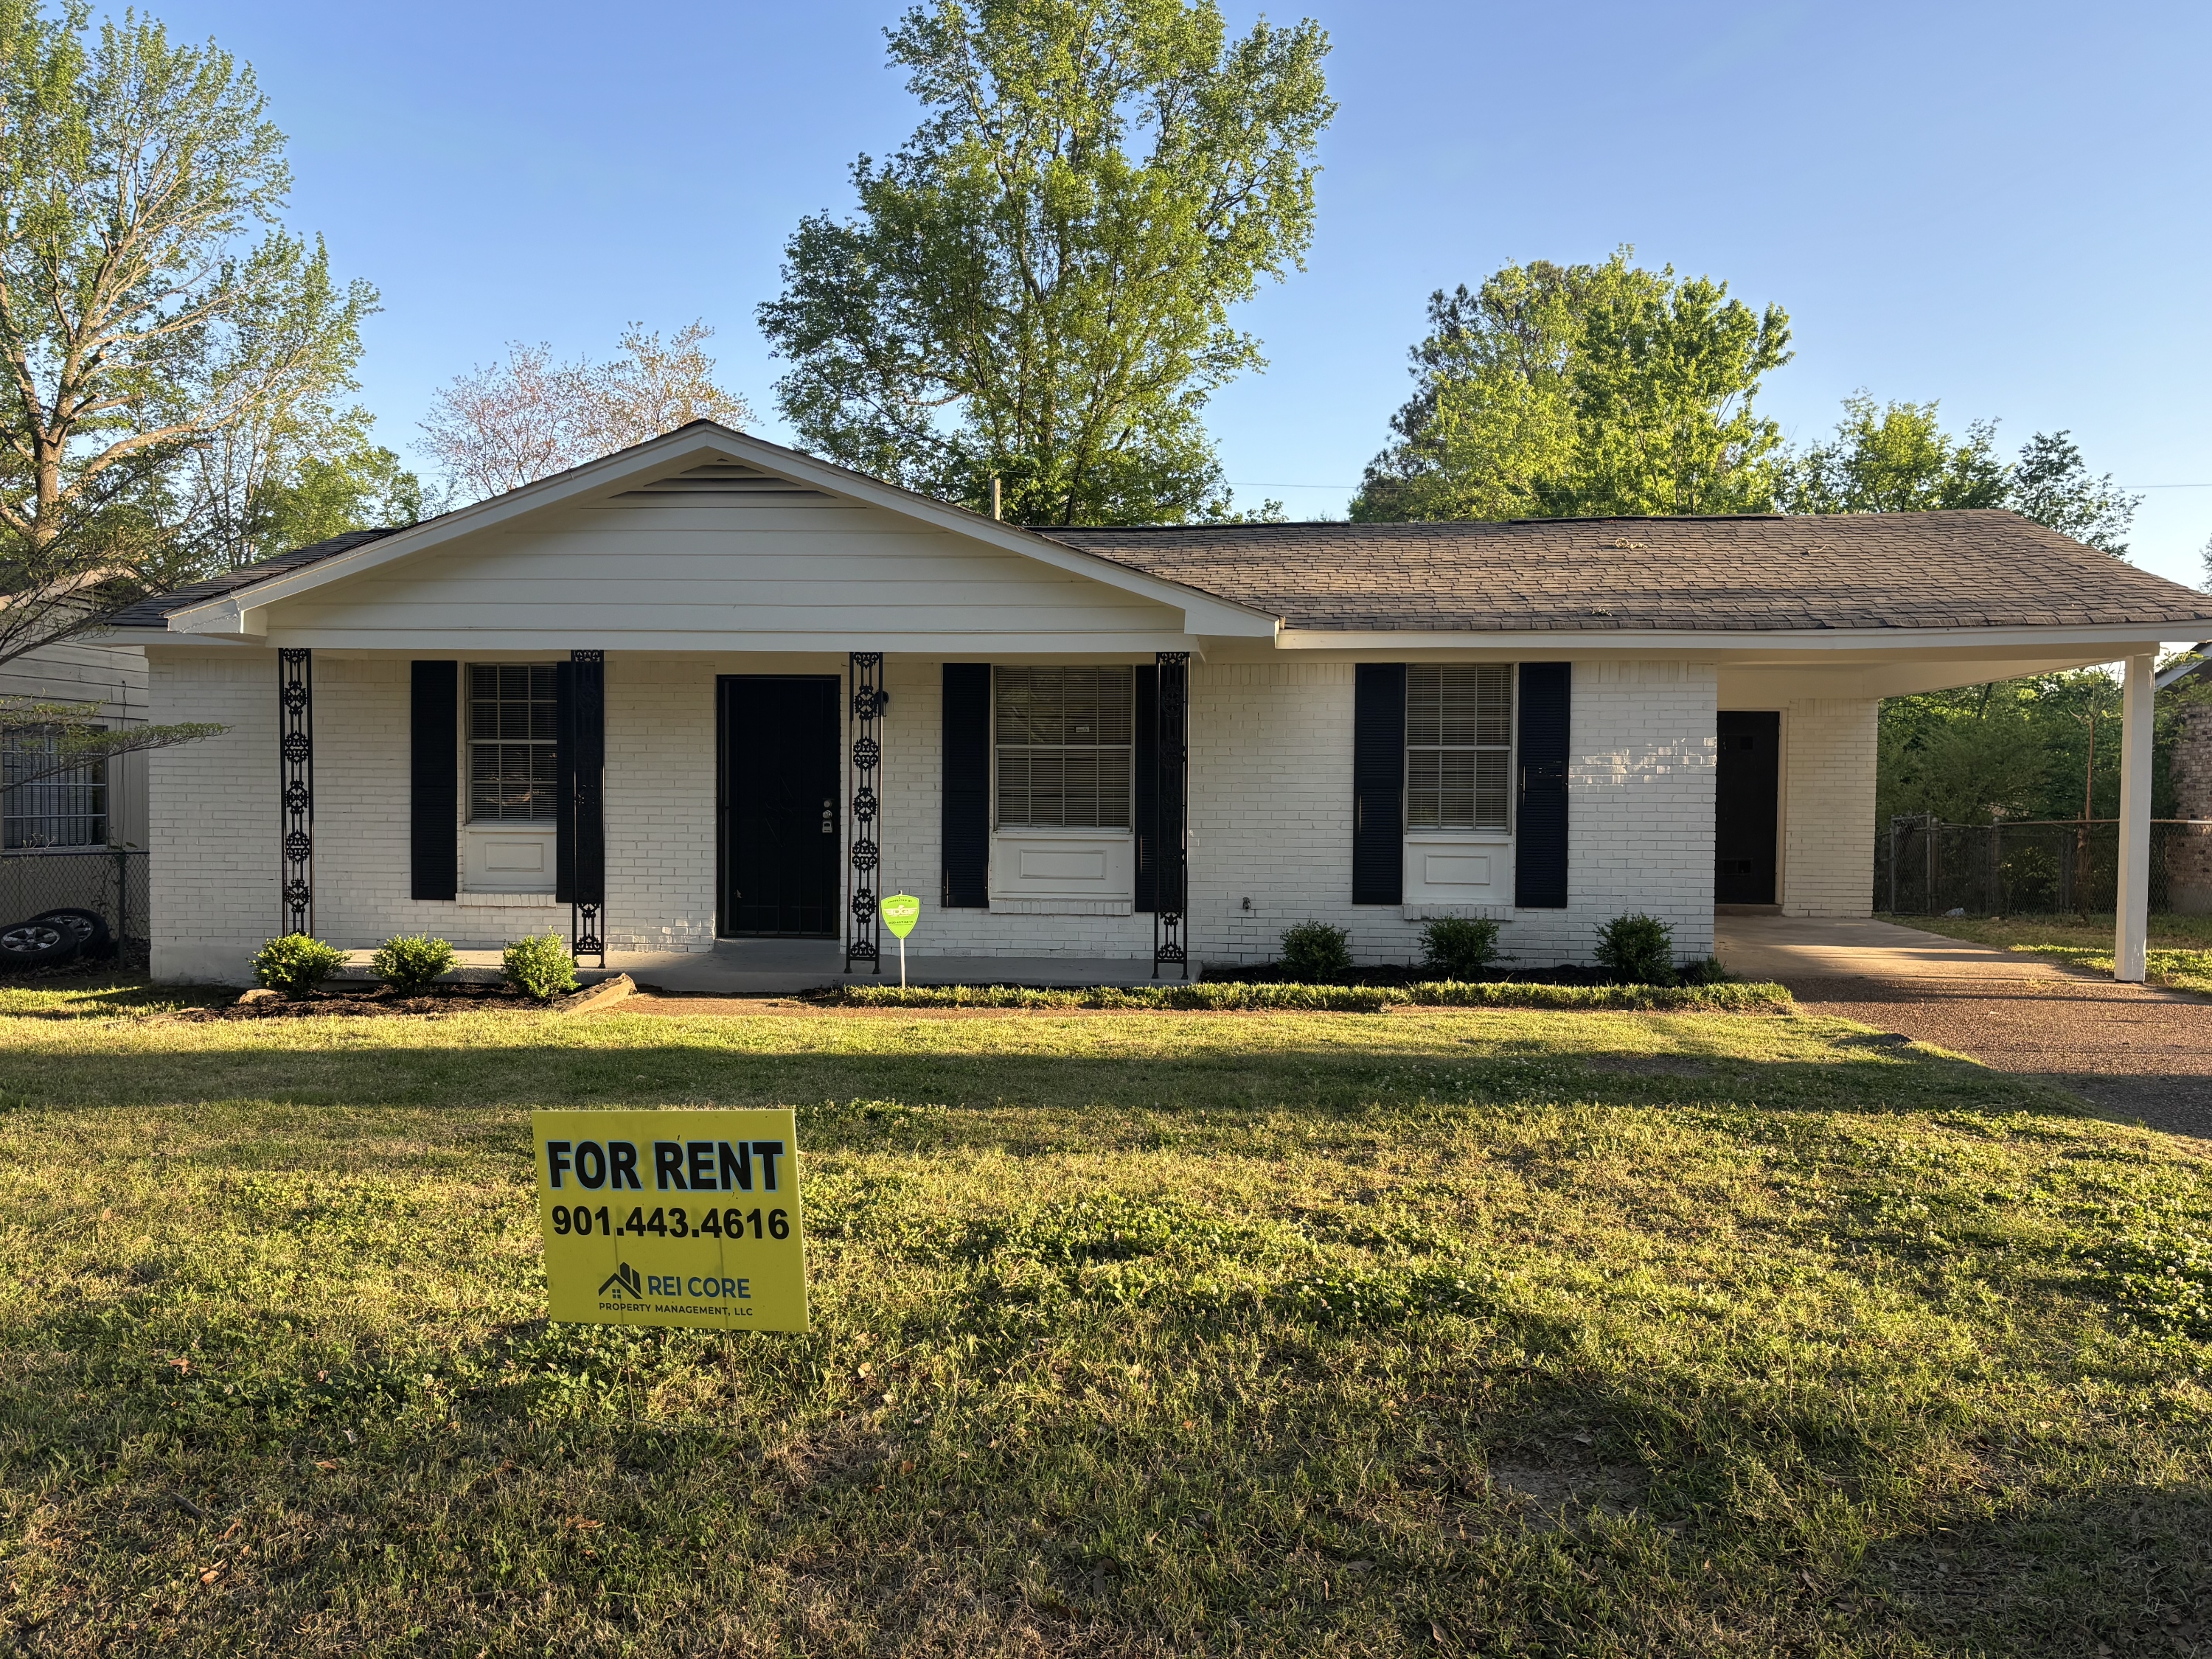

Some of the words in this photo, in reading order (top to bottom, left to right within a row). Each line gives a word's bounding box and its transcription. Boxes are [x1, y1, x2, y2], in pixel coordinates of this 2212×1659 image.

[546, 1140, 644, 1191] FOR
[653, 1140, 785, 1192] RENT
[552, 1205, 790, 1239] 901.443.4616
[647, 1276, 681, 1296] REI
[687, 1276, 751, 1298] CORE
[599, 1302, 651, 1312] PROPERTY
[655, 1304, 731, 1316] MANAGEMENT,
[734, 1307, 753, 1316] LLC
